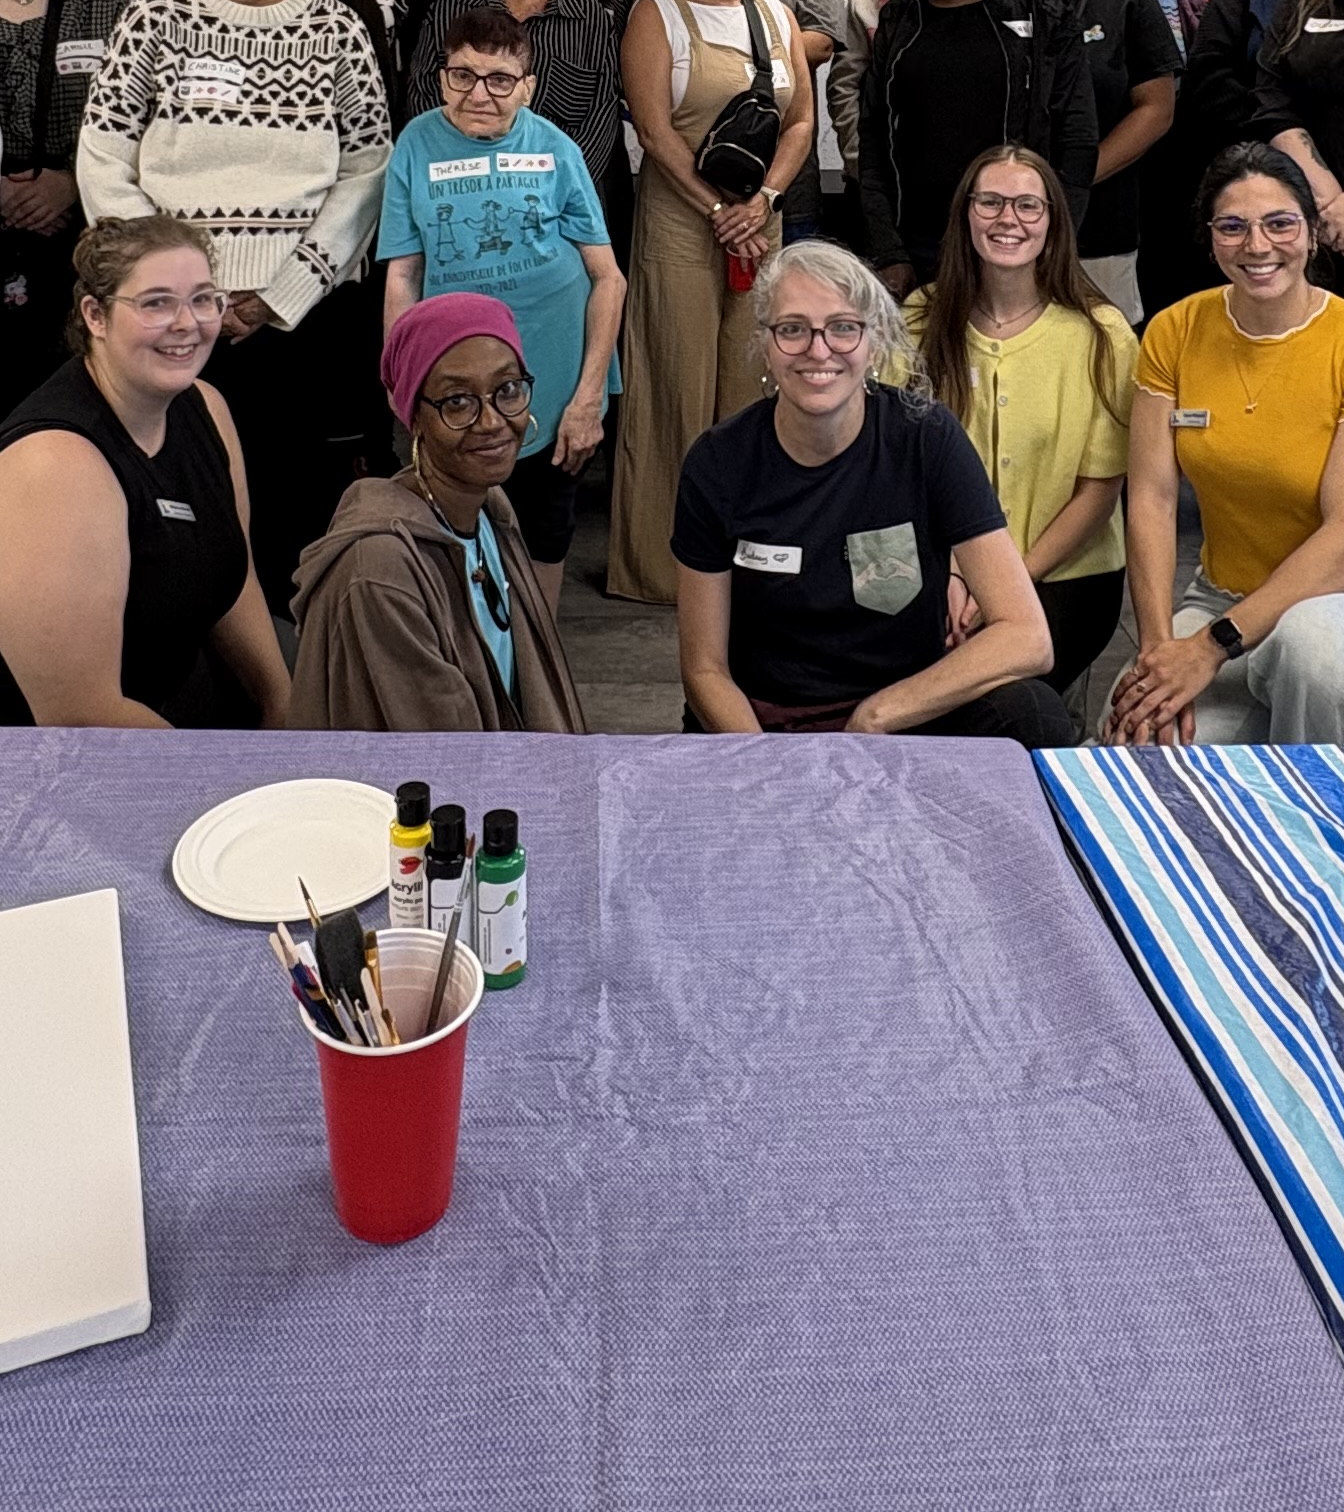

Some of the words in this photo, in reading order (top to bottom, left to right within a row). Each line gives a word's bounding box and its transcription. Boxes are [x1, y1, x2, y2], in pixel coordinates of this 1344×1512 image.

[187, 61, 241, 76] CHRISTINE
[427, 182, 445, 200] UN
[446, 177, 483, 196] TRÉSOR
[496, 175, 541, 190] PARTAGER
